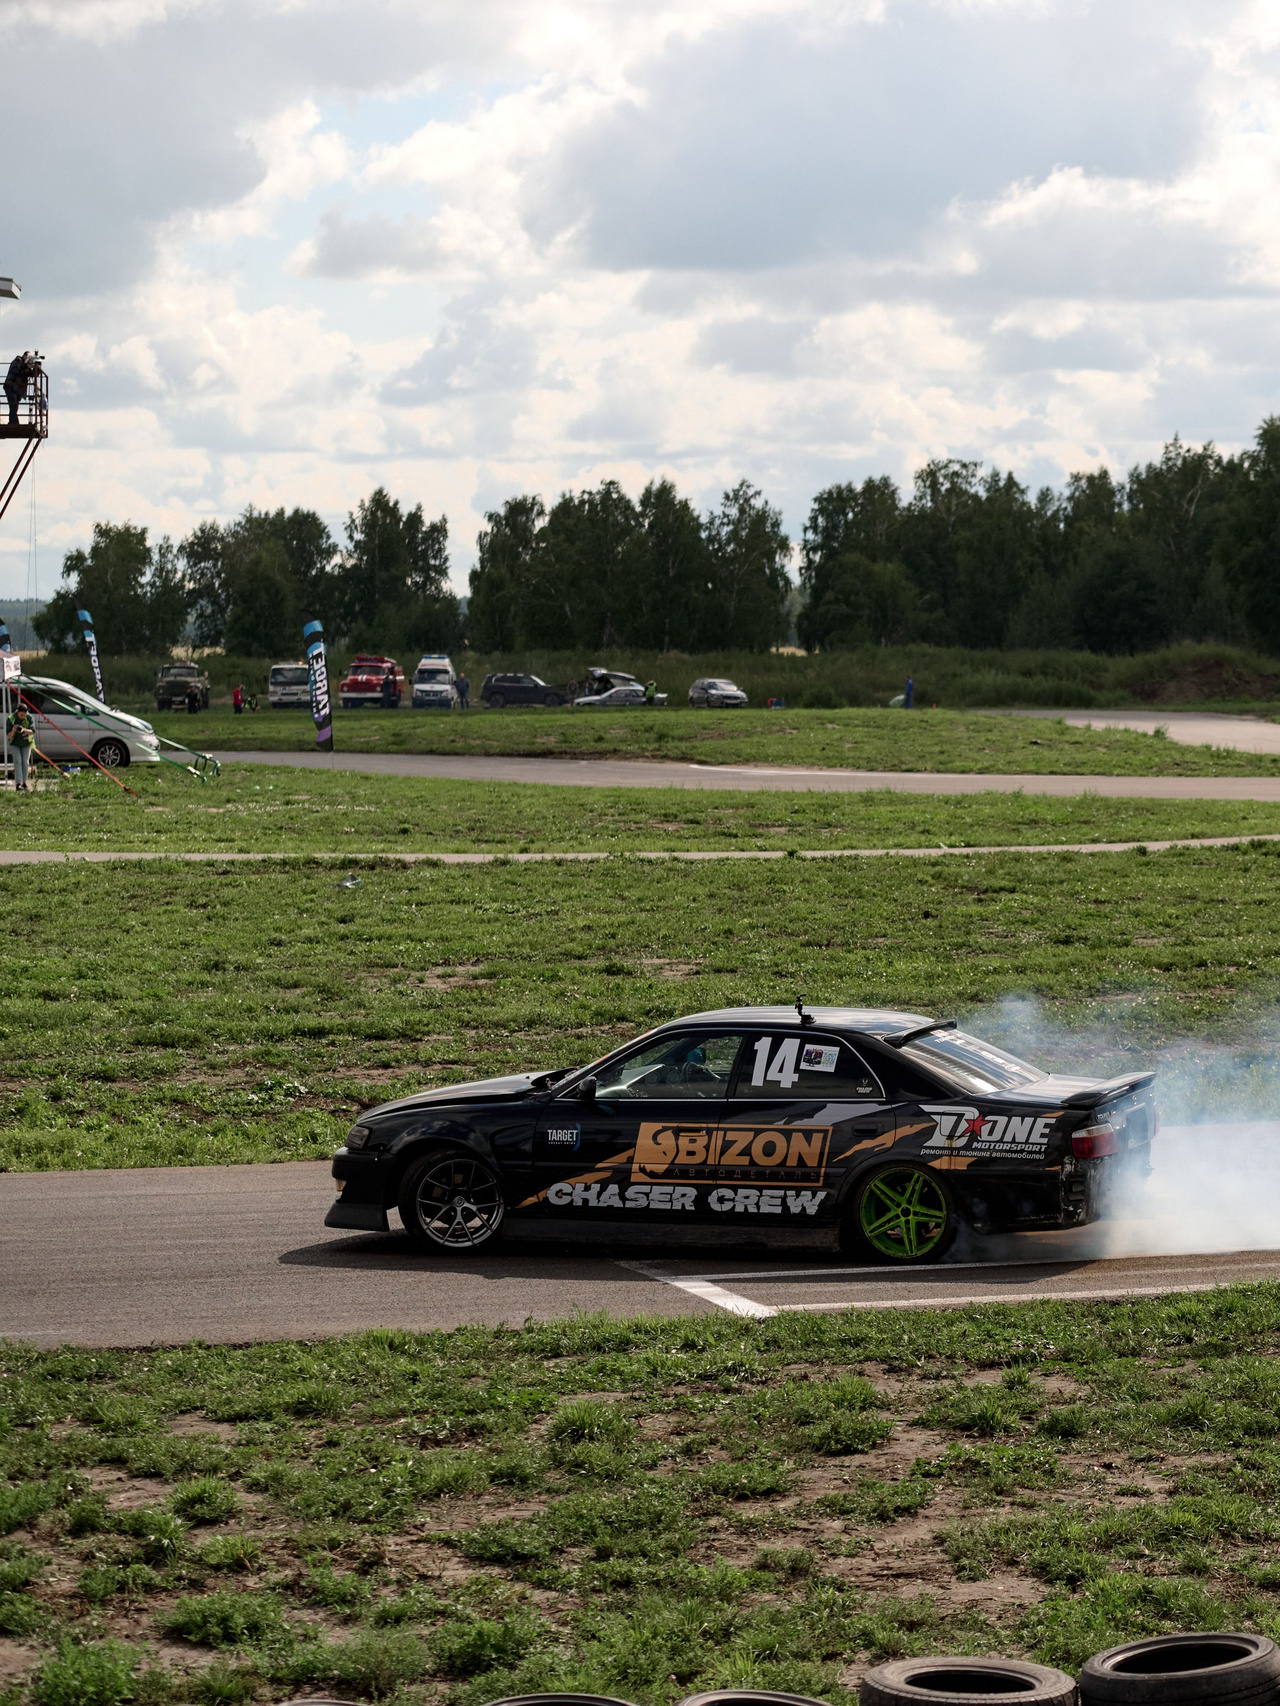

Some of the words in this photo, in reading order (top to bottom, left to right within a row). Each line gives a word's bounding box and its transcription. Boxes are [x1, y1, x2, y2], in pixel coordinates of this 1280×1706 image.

[751, 1036, 801, 1089] 14
[547, 1129, 578, 1141] TARGET
[674, 1130, 824, 1167] BIZON
[920, 1148, 951, 1156] ремонт
[992, 1150, 1045, 1160] автомобилей
[972, 1141, 1048, 1152] MOTORSPORT
[546, 1182, 698, 1211] CHASER
[708, 1187, 828, 1215] CREW
